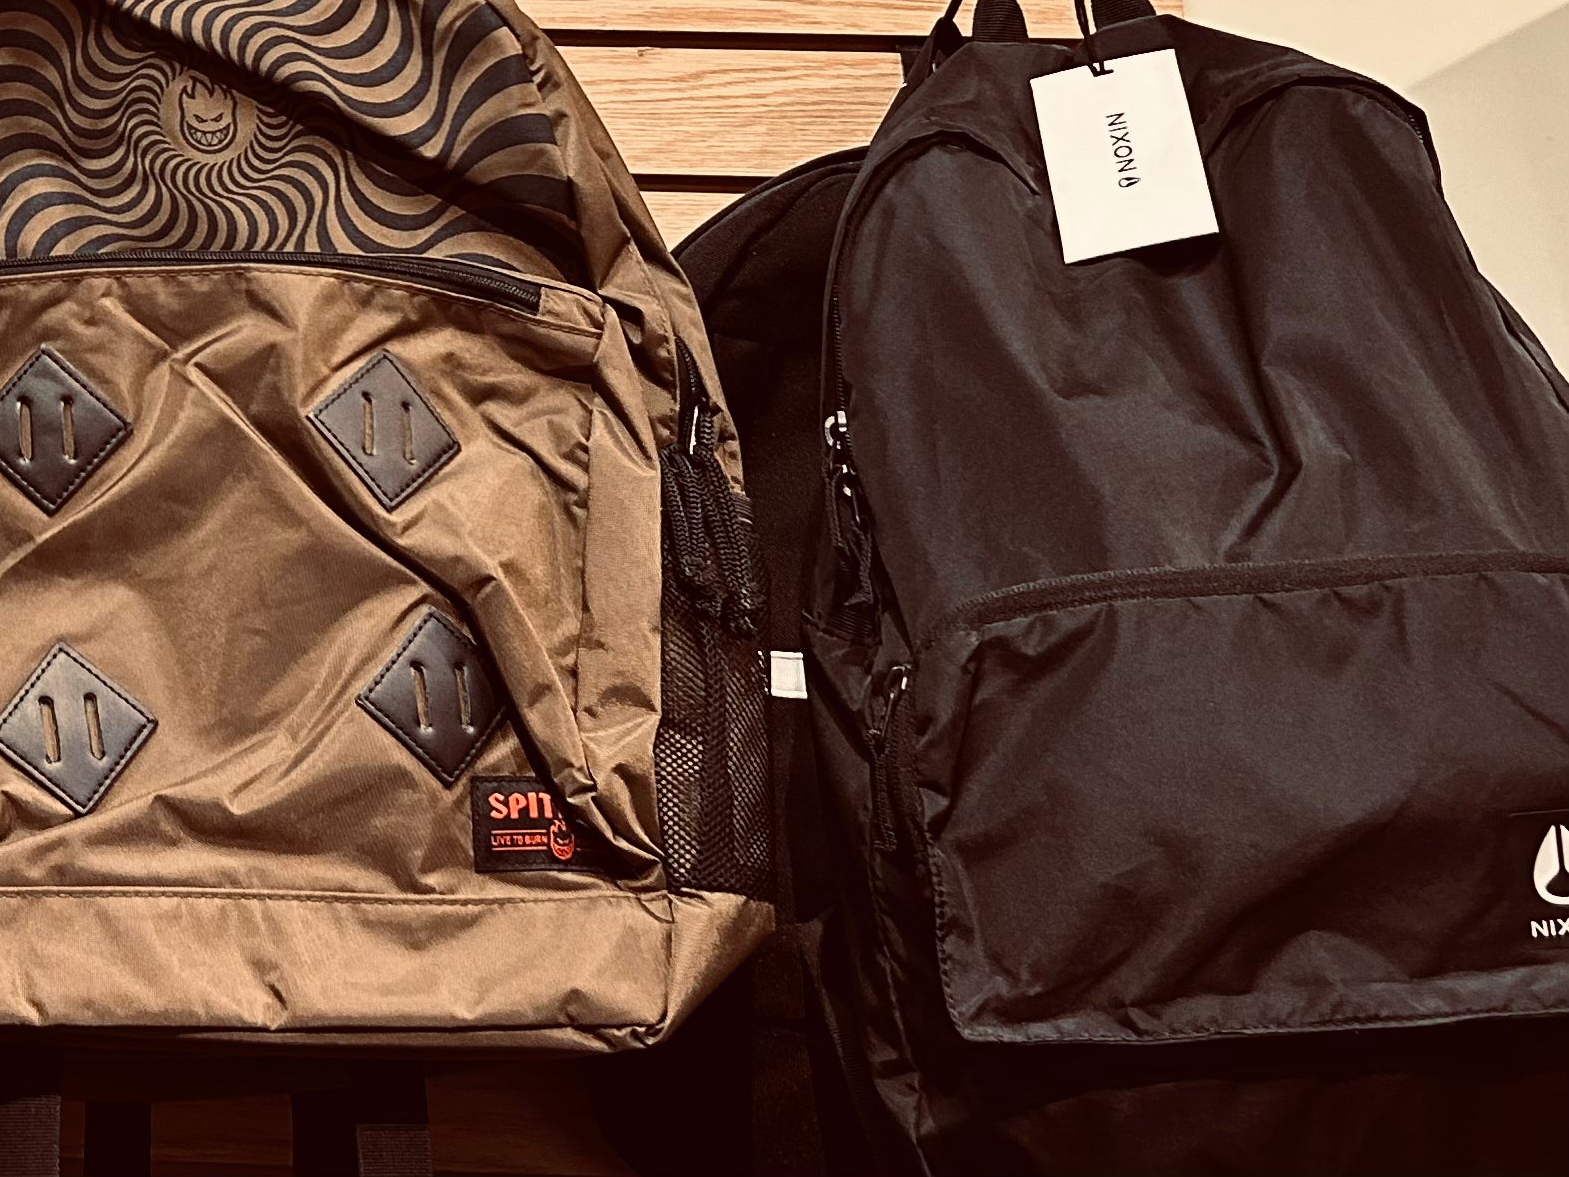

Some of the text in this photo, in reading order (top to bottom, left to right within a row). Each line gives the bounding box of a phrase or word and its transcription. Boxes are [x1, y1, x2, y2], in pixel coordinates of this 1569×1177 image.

[1105, 112, 1137, 173] NIXON
[491, 834, 549, 845] LIVE TO BURN
